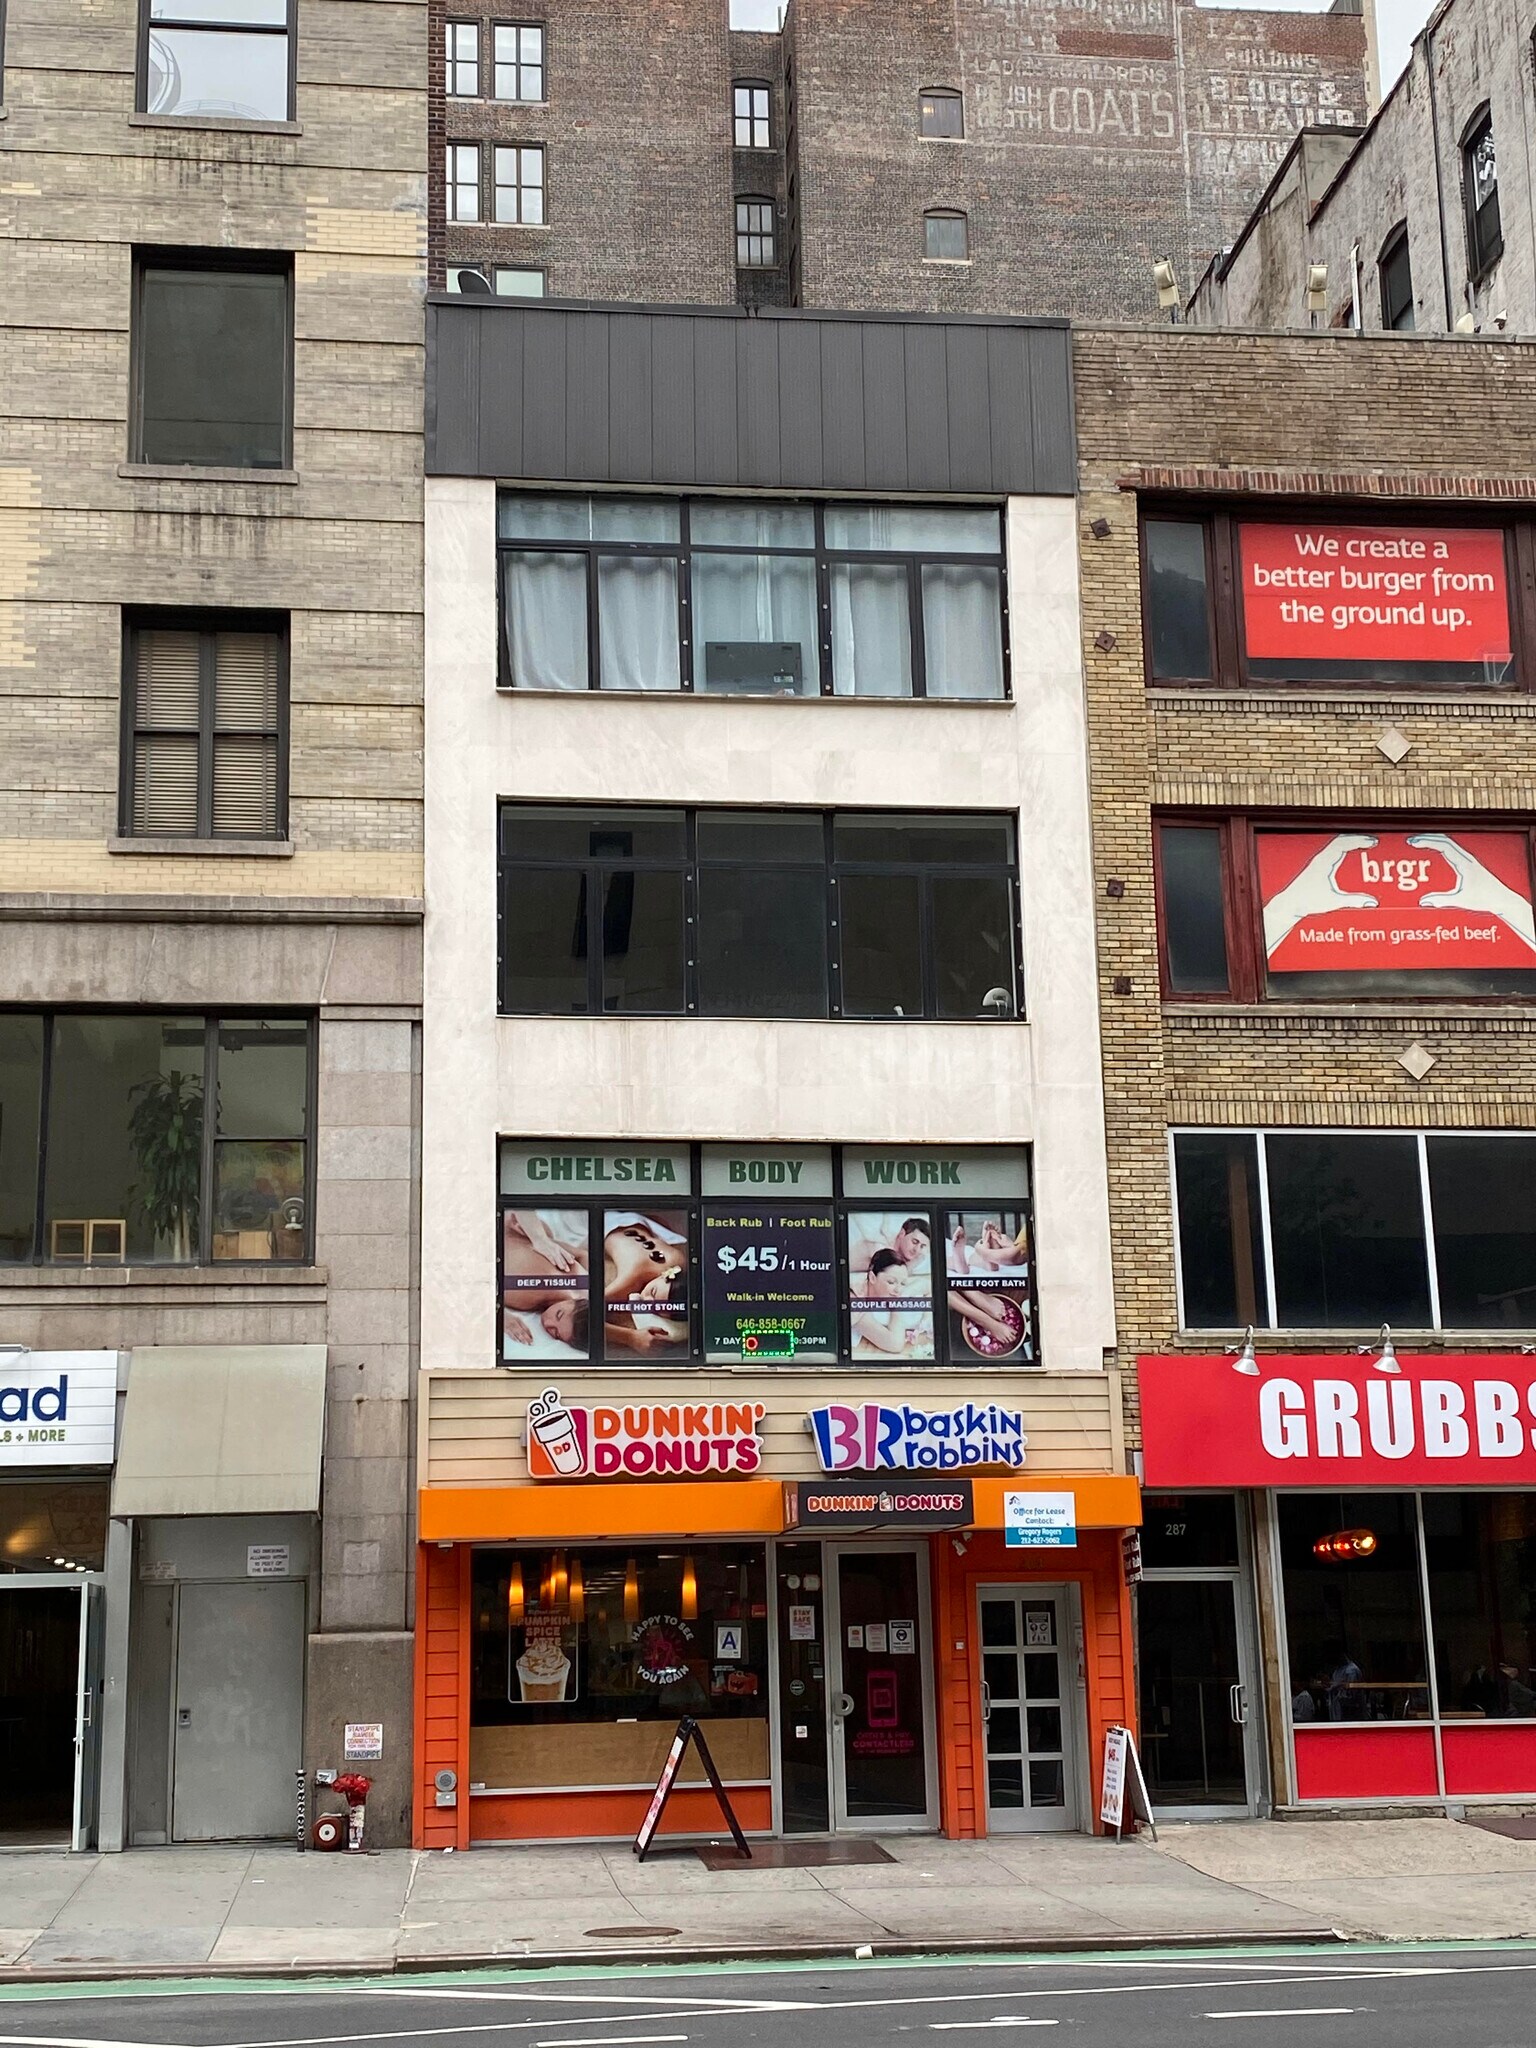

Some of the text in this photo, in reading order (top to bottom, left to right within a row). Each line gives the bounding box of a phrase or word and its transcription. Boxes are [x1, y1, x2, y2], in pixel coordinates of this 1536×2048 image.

[1049, 86, 1175, 138] COATS
[1294, 533, 1449, 560] We create a
[1253, 563, 1494, 597] better burger from
[1279, 599, 1473, 632] the ground up.
[1360, 851, 1431, 892] brgr
[1300, 925, 1502, 945] Made from grass-fed beef.
[526, 1157, 961, 1184] CHELSEA BODY WORK
[707, 1218, 736, 1227] Back
[740, 1218, 763, 1227] Rub
[780, 1218, 806, 1227] Foot
[809, 1218, 832, 1227] Rub
[801, 1260, 831, 1270] Hour
[543, 1278, 577, 1286] TISSUE
[726, 1293, 814, 1301] Walk-in Welcome
[851, 1301, 887, 1309] COUPLE
[608, 1303, 686, 1311] FREE HOT STONE
[736, 1318, 807, 1330] 646-858-0667
[723, 1337, 743, 1345] DAY
[793, 1337, 826, 1345] 0:30PM
[594, 1404, 764, 1439] DUNKIN'
[903, 1403, 1022, 1438] baskin
[1260, 1378, 1536, 1459] GRUBB
[28, 1429, 66, 1442] MORE
[552, 1442, 571, 1456] DD
[594, 1438, 759, 1473] DONUTS
[905, 1436, 1023, 1468] robbins
[808, 1495, 878, 1512] DUNKIN'
[895, 1494, 963, 1511] DONUTS
[1013, 1507, 1033, 1516] Office
[1034, 1507, 1044, 1516] for
[1018, 1528, 1062, 1536] Gregory Rogers
[1165, 1523, 1186, 1535] 287
[517, 1616, 571, 1626] PUMPKIN
[632, 1615, 694, 1641] HAPPY TO SEE
[526, 1627, 561, 1636] SPICE
[525, 1637, 562, 1647] LATTE
[721, 1631, 737, 1649] A
[637, 1664, 689, 1685] YOU AGAIN
